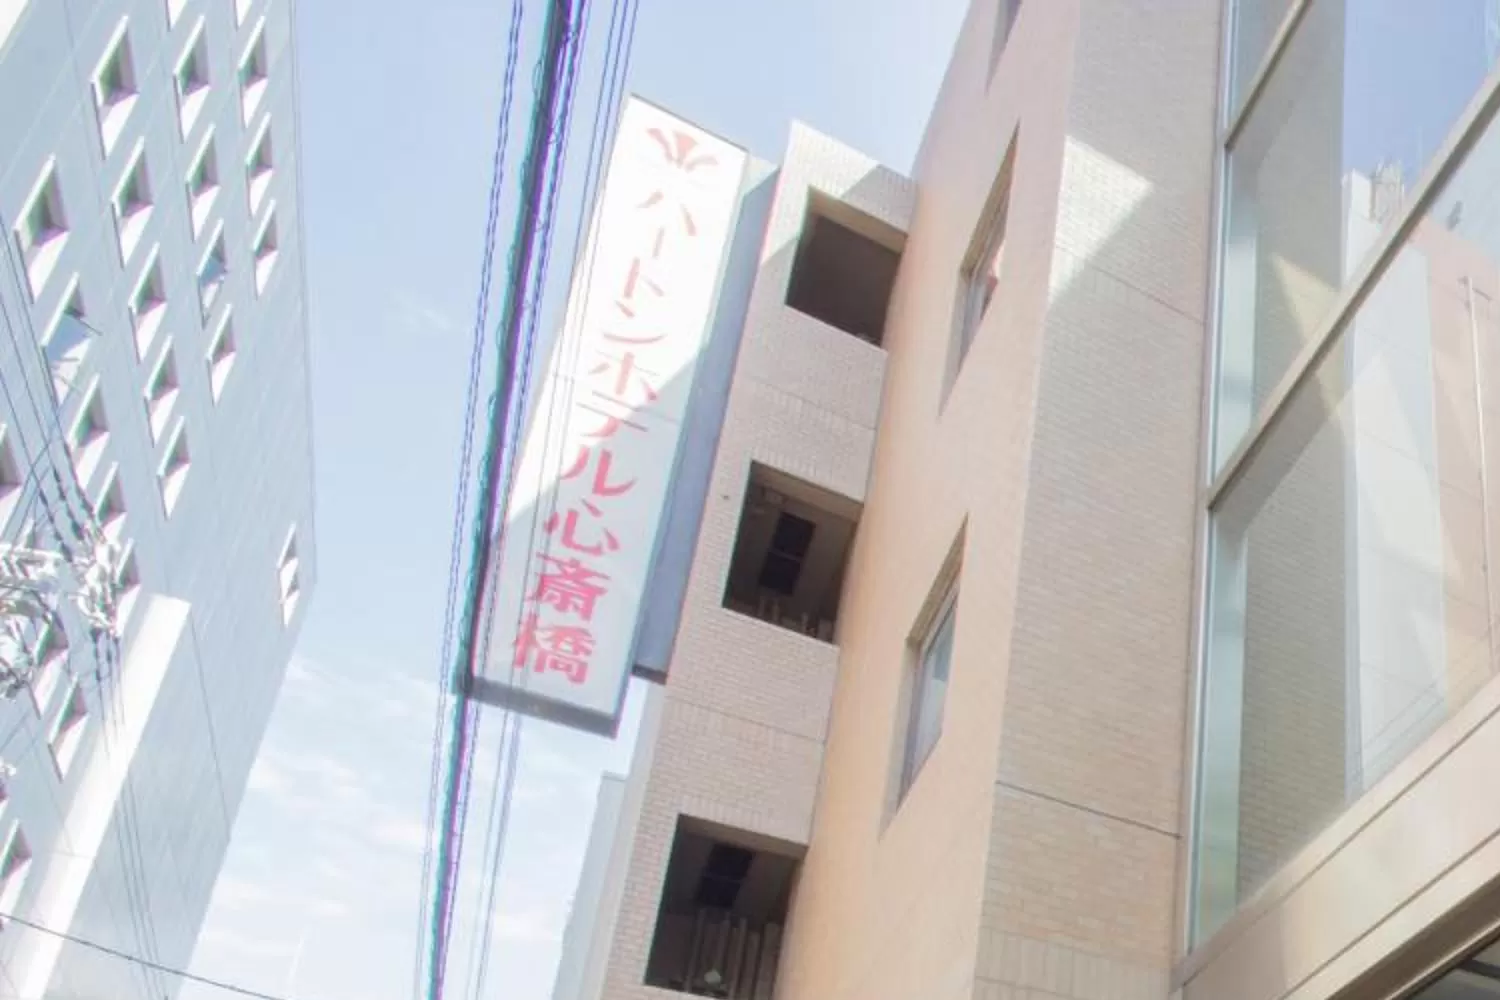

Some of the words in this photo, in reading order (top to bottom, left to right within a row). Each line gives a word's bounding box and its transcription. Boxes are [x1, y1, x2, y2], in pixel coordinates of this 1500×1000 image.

[513, 190, 698, 685] ハートンホテル心斎橋
